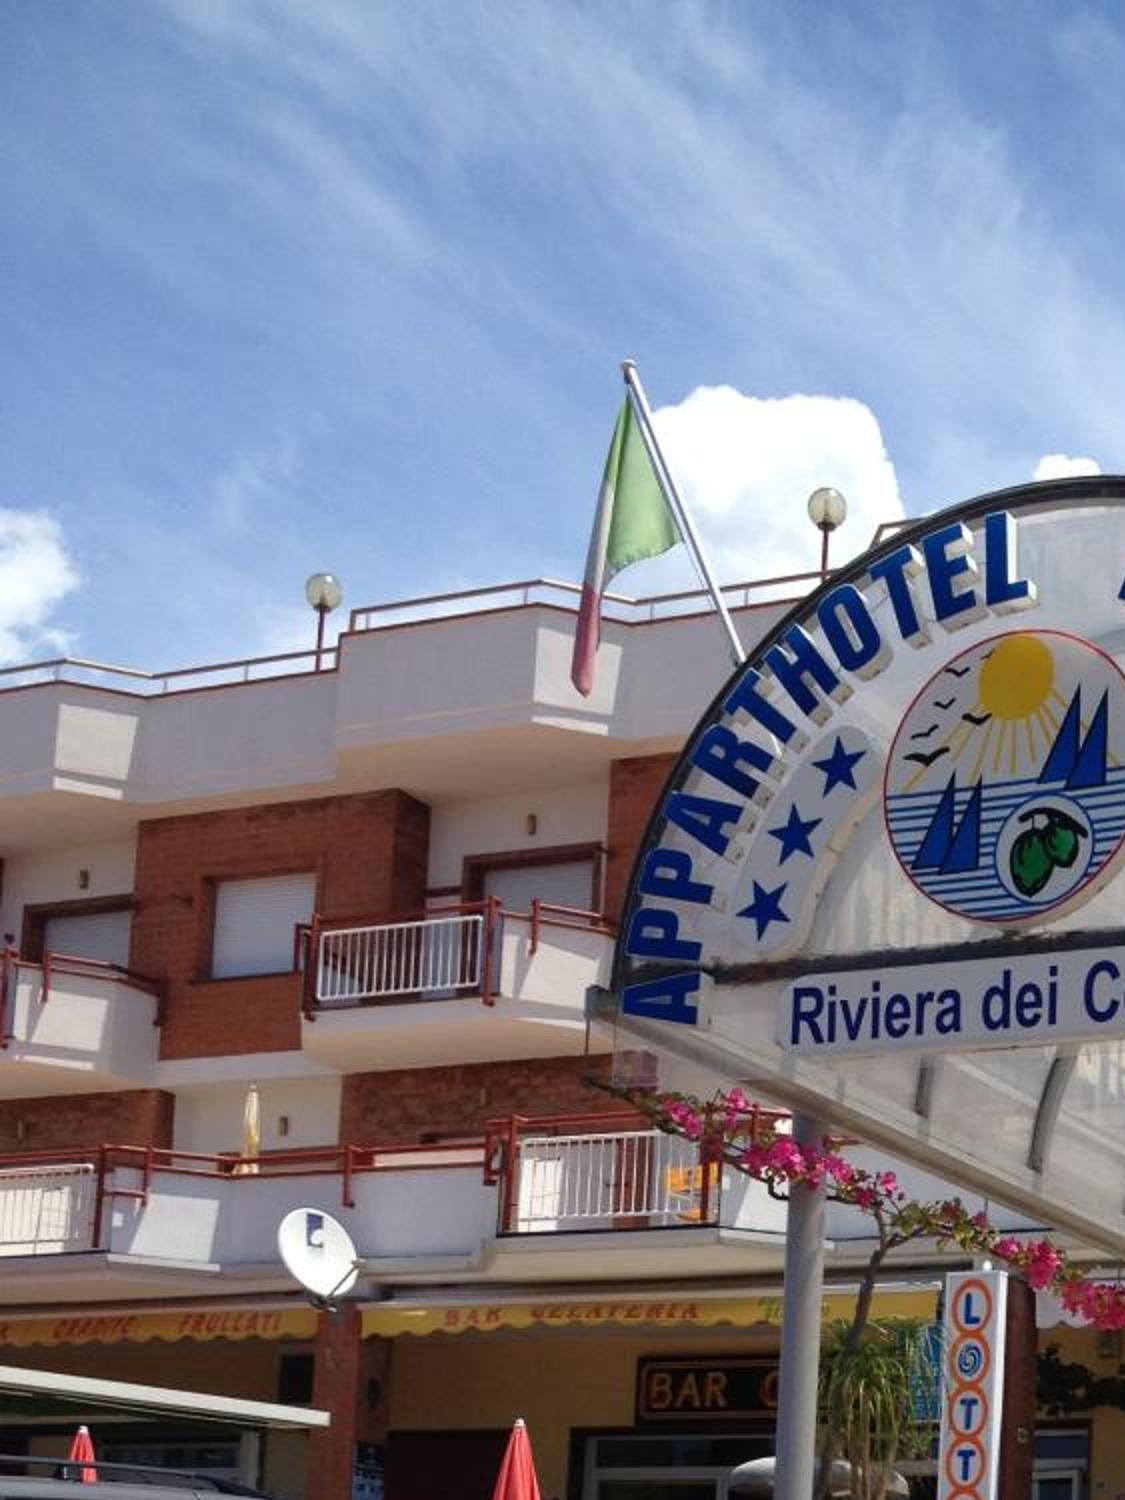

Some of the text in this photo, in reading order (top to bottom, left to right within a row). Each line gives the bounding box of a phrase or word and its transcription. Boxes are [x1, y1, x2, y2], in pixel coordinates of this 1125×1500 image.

[622, 510, 1038, 1026] APPARTHOTEL
[790, 982, 963, 1046] Riviera
[981, 964, 1060, 1029] dei
[445, 1308, 501, 1327] BAR
[649, 1371, 728, 1409] BAR
